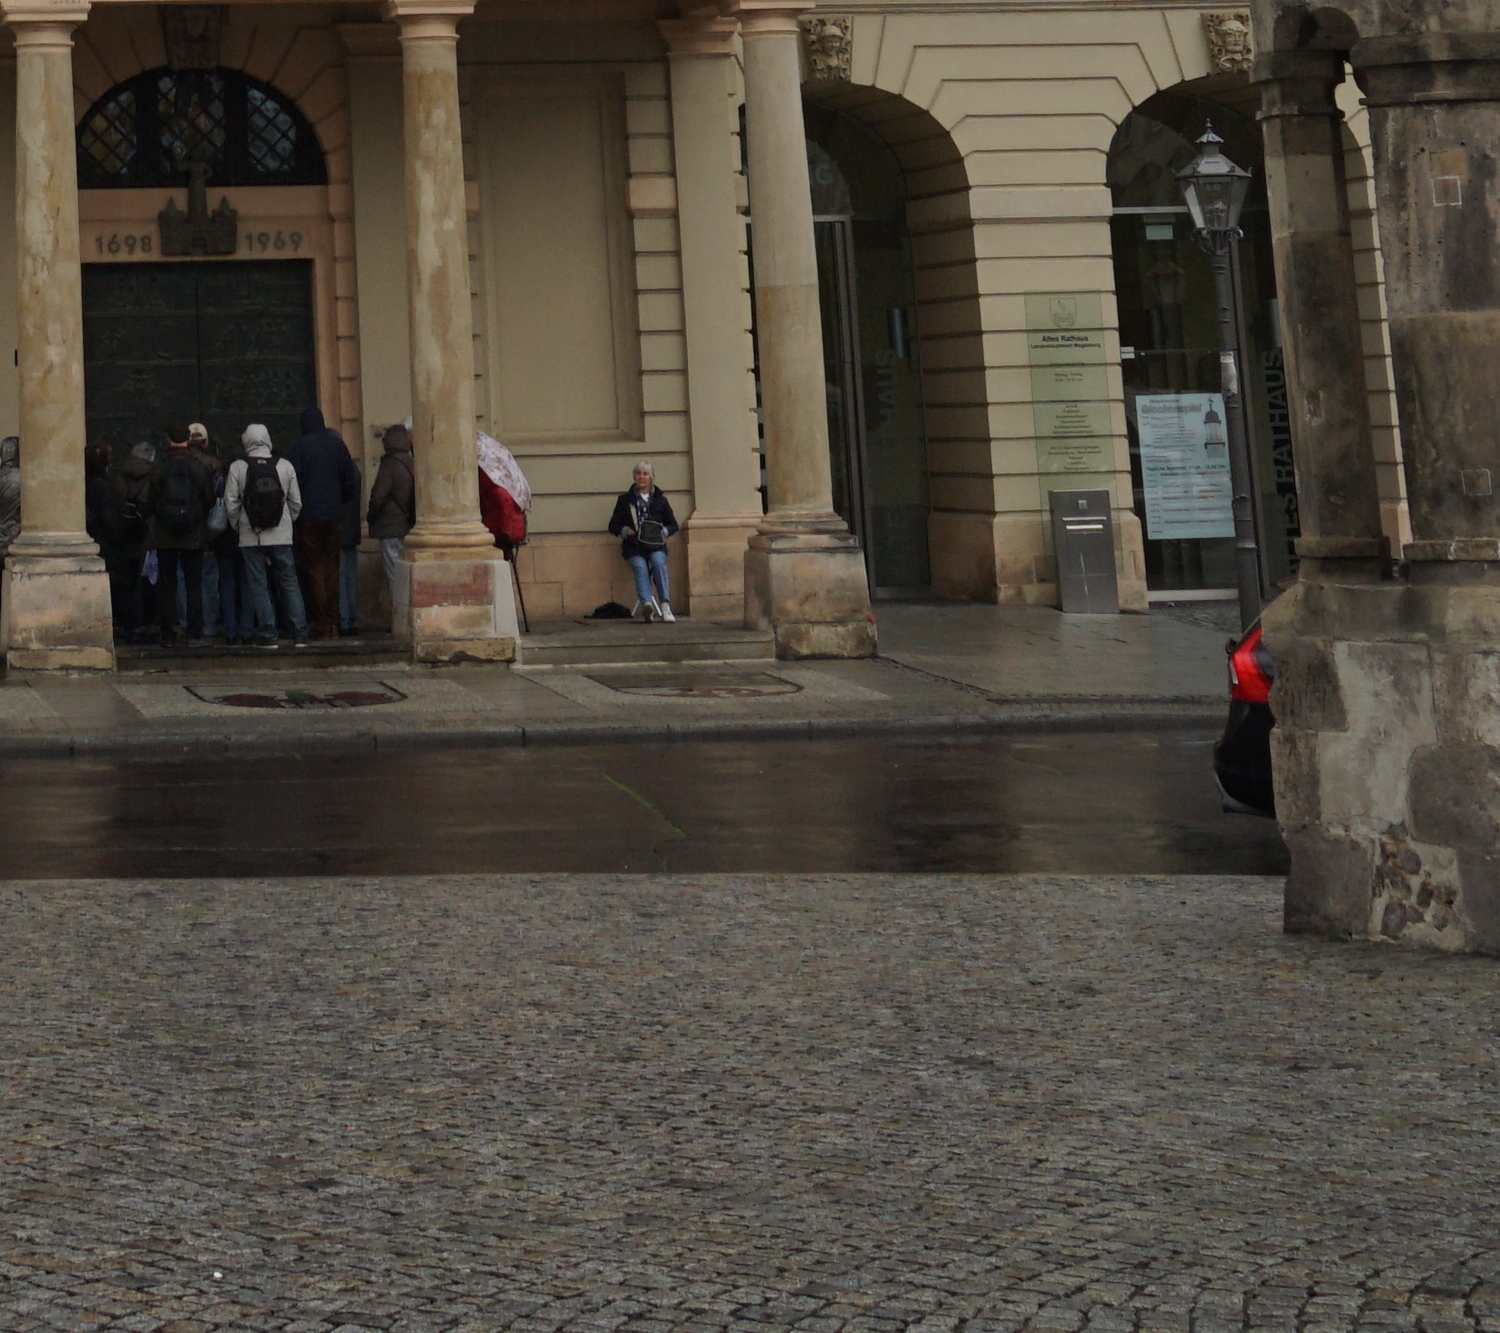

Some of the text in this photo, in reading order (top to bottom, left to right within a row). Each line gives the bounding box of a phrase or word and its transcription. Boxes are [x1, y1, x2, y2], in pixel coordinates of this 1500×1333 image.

[95, 233, 153, 256] 1698
[245, 230, 304, 252] 1969
[1262, 350, 1293, 484] RATHAUS
